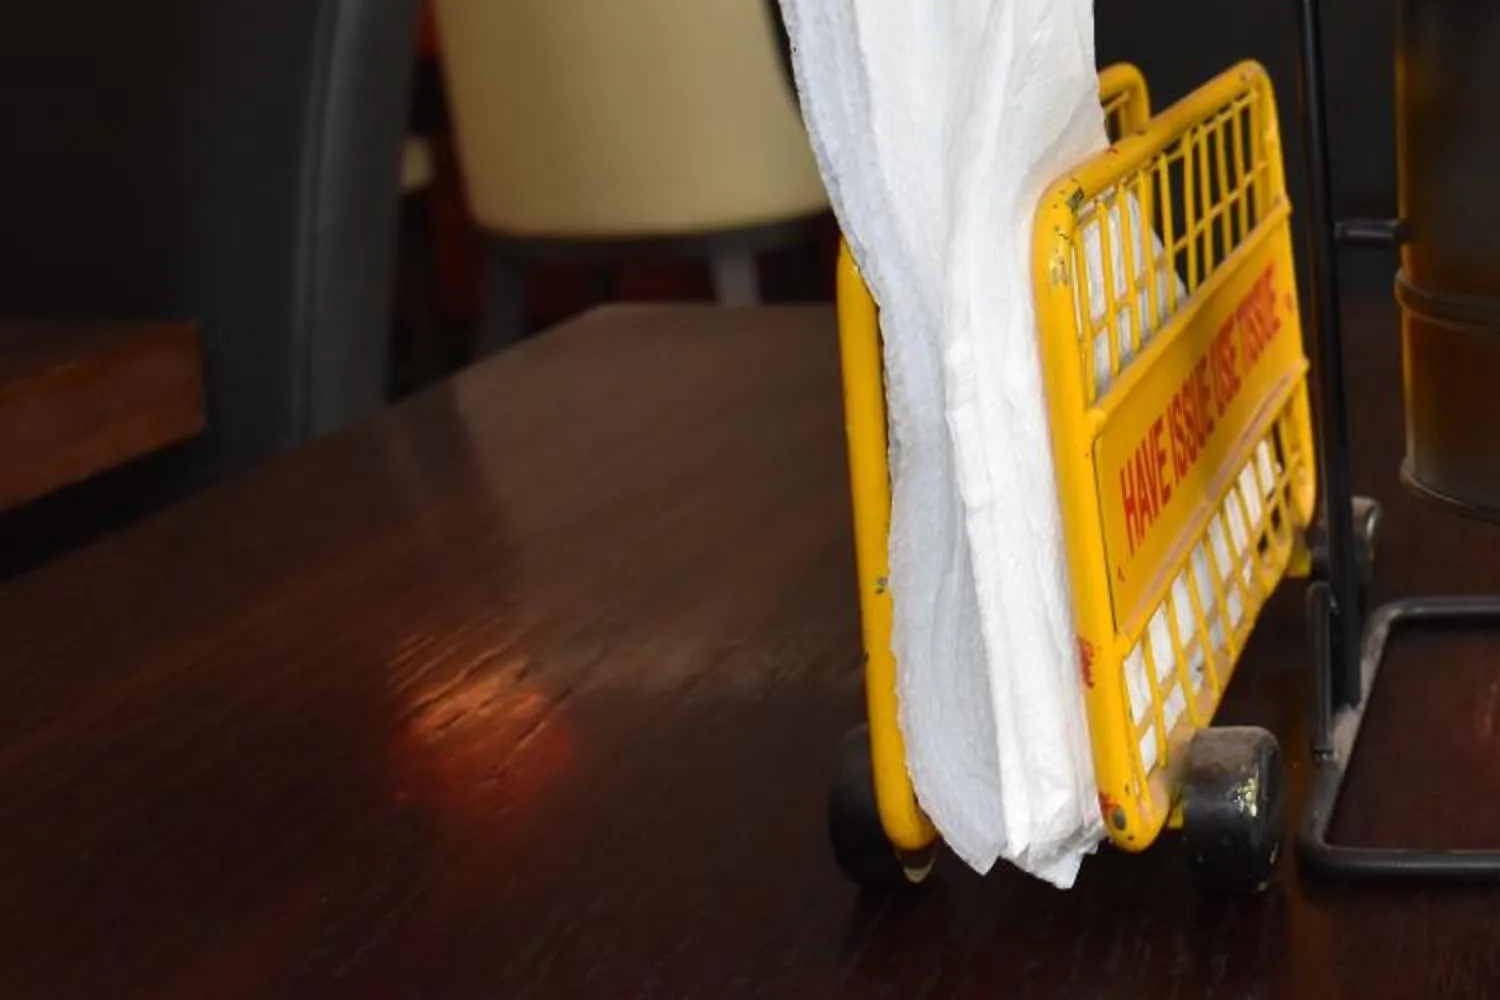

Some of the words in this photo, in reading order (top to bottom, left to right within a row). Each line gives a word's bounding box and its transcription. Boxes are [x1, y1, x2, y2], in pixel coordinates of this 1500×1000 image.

[1119, 416, 1172, 556] HAVE
[1165, 354, 1215, 488] ISSUE
[1209, 312, 1242, 418] USE
